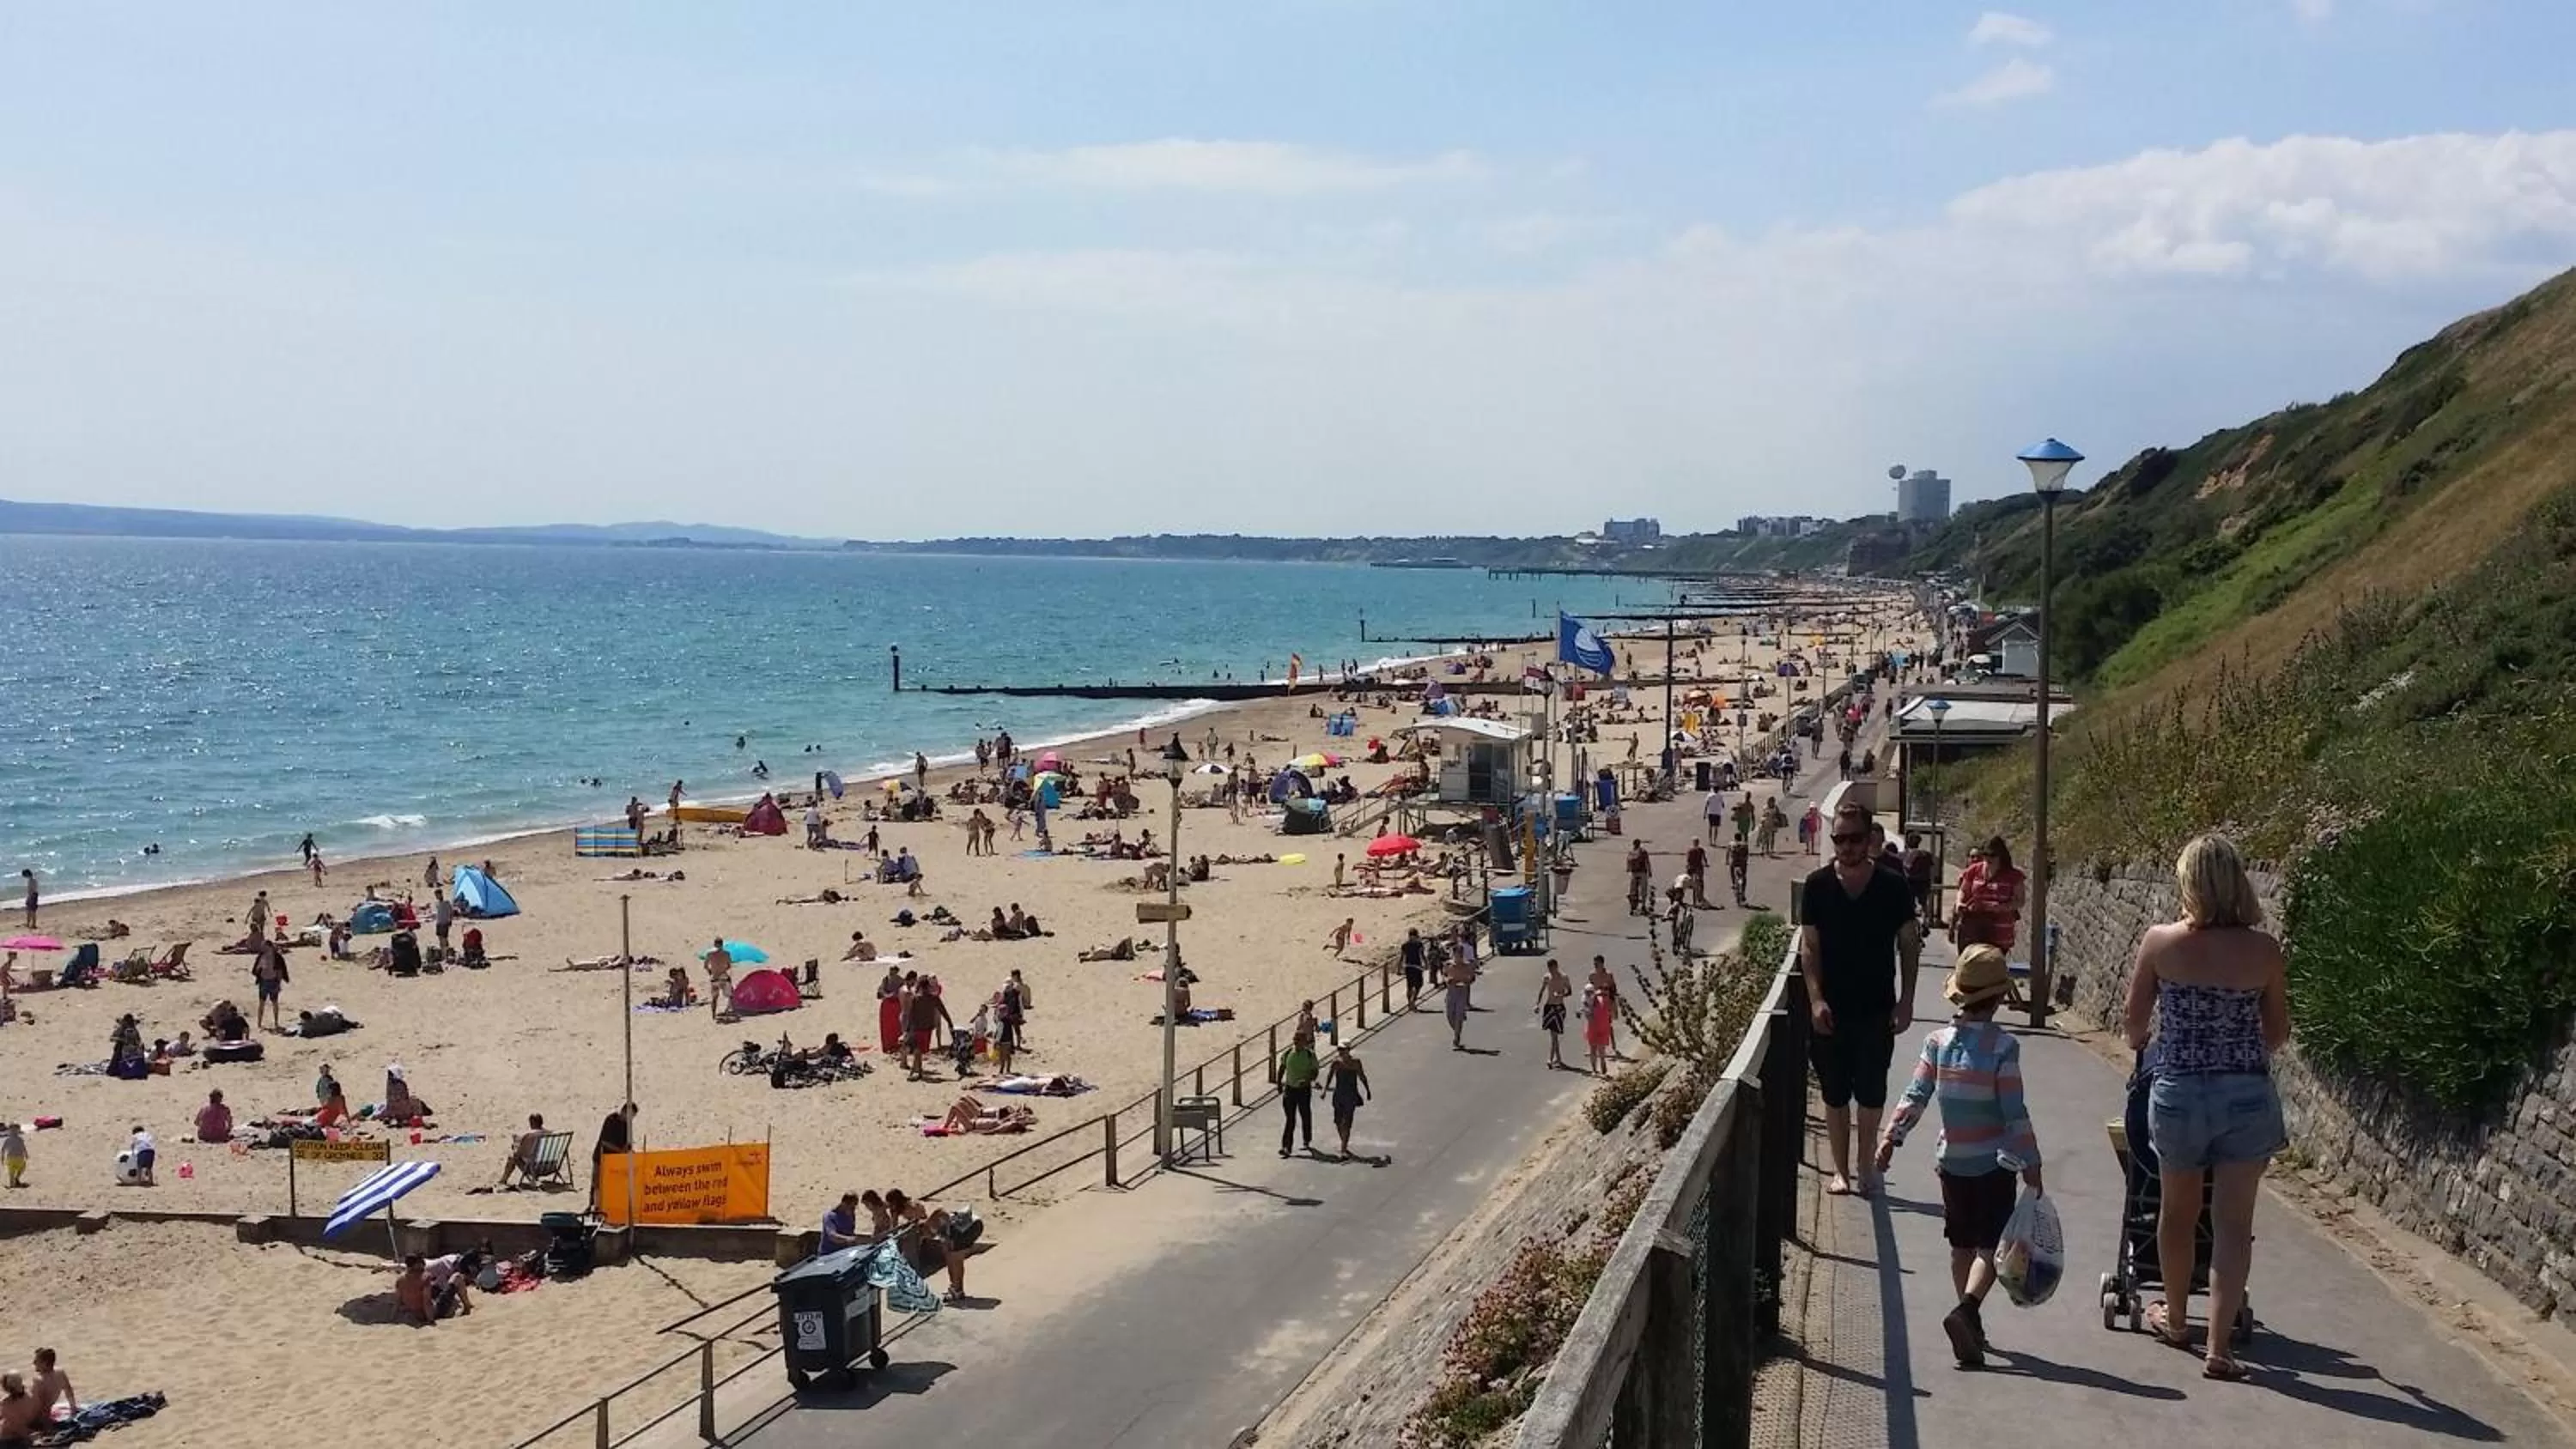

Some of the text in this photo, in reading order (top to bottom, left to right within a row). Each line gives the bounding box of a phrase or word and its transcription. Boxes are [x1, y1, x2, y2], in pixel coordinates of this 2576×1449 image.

[295, 1140, 384, 1151] CAUTION KEEP CLEAR
[655, 1161, 721, 1178] Always swim
[644, 1175, 728, 1195] between the red
[643, 1194, 727, 1213] and yellow flags
